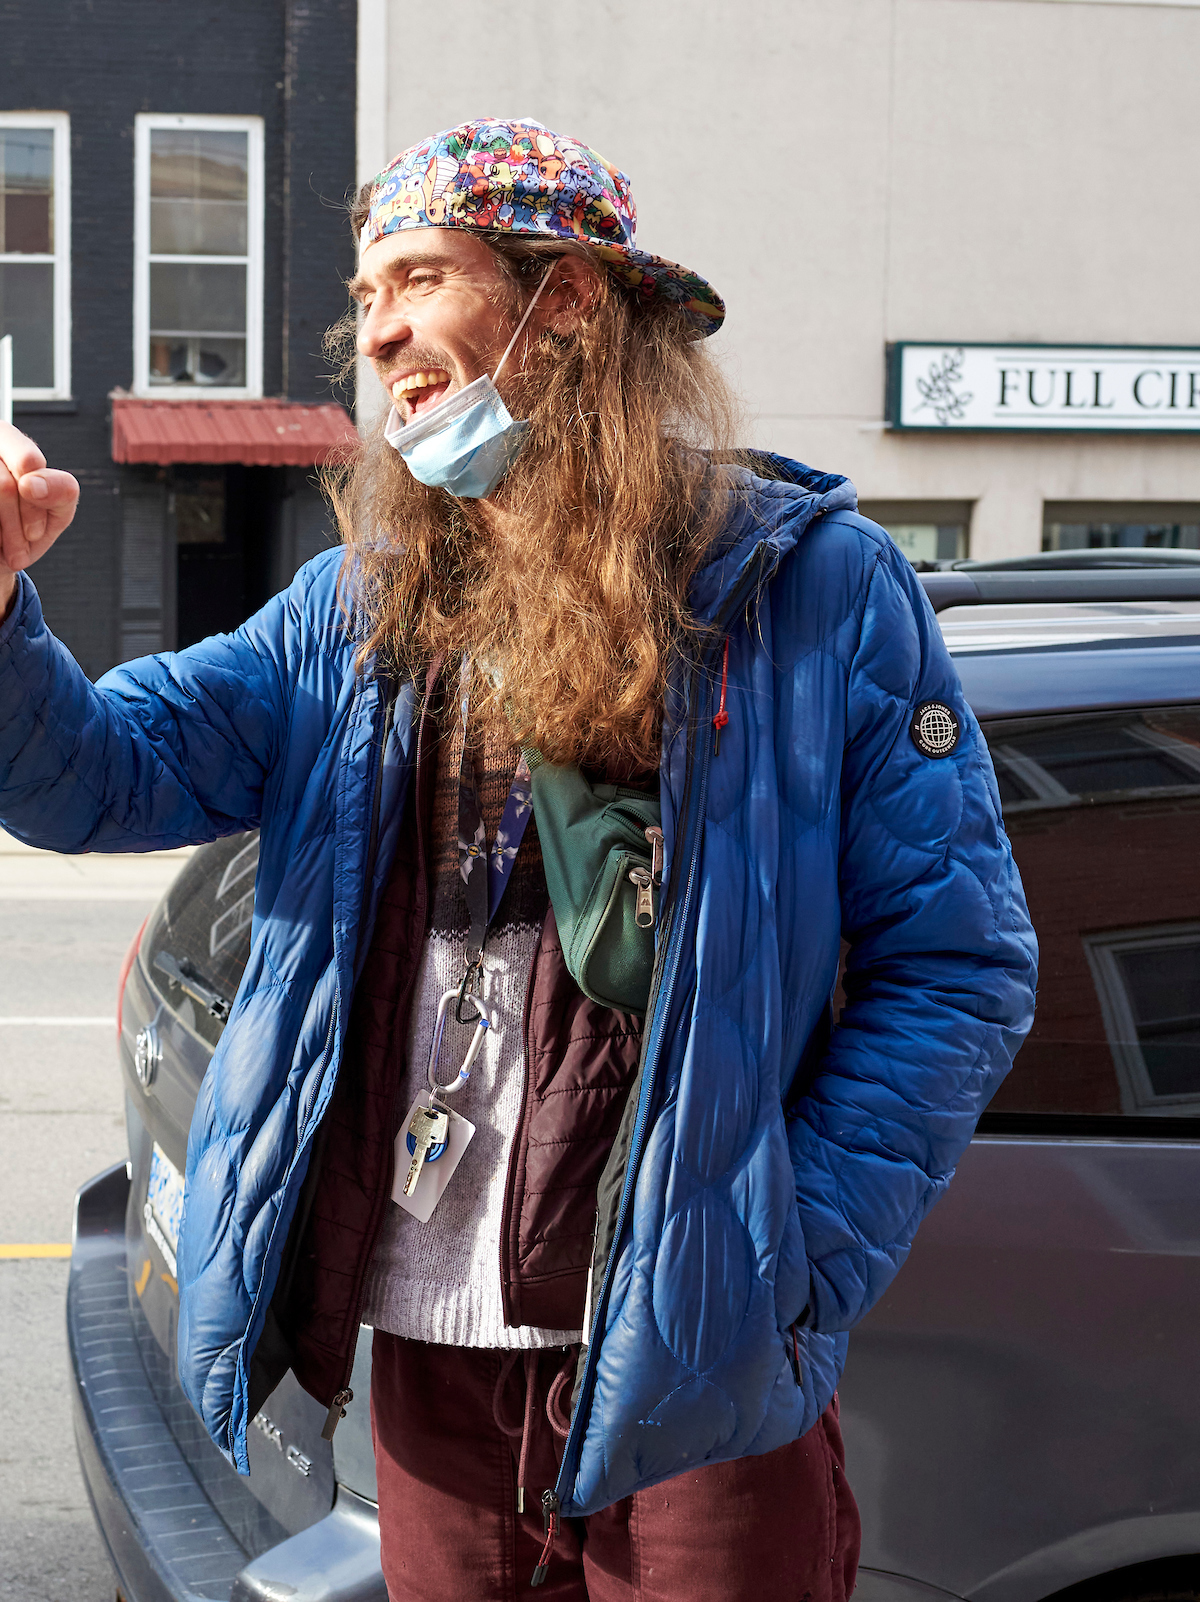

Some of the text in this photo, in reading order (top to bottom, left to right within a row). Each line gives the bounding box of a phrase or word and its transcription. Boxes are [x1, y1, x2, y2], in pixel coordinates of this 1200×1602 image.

[996, 368, 1115, 409] FULL
[919, 705, 931, 716] JACK
[935, 704, 951, 716] JONES
[918, 735, 957, 754] CORE OUTERWEAR
[286, 1445, 312, 1476] CE
